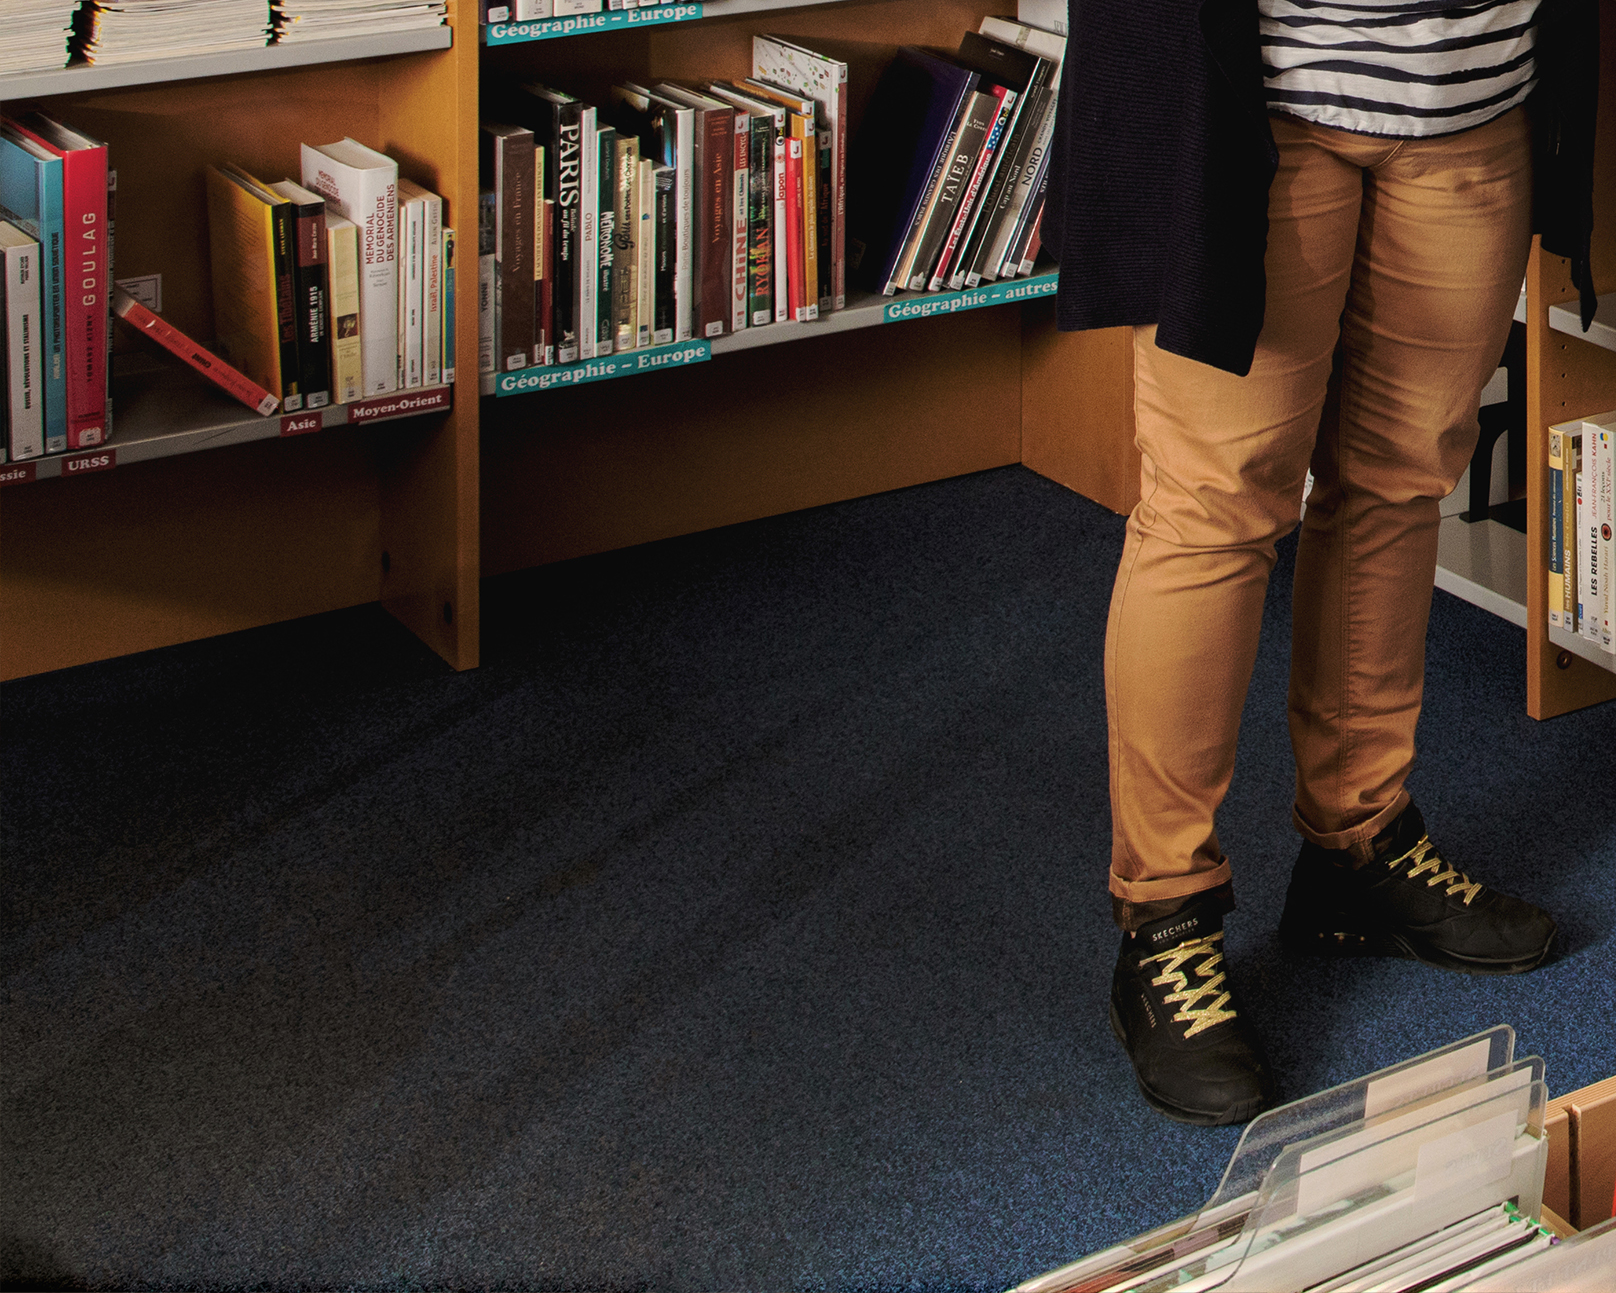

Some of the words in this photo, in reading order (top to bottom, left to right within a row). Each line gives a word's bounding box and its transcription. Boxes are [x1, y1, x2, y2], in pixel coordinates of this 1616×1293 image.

[491, 14, 605, 40] Géographie
[626, 4, 697, 24] Europe
[560, 123, 579, 206] PARIS
[940, 153, 969, 203] TAÏEB
[1020, 146, 1044, 186] NORD
[776, 172, 786, 201] Japon
[375, 196, 384, 245] GENOCIDE
[385, 184, 394, 241] ARMENIENS
[365, 213, 375, 264] MEMORIAL
[376, 249, 385, 263] DU
[386, 243, 395, 260] DES
[82, 212, 96, 306] GOULAG
[309, 286, 318, 304] 1915
[888, 293, 988, 317] Géographie
[1005, 280, 1058, 298] autres
[309, 306, 319, 342] ARMÉNIE
[501, 364, 615, 391] Géographie
[636, 345, 705, 370] Europe
[287, 416, 316, 431] Asie
[353, 393, 442, 418] Moyen-Orient
[0, 468, 26, 481] ssie
[68, 455, 110, 471] URSS
[1152, 918, 1198, 941] SKECHERS
